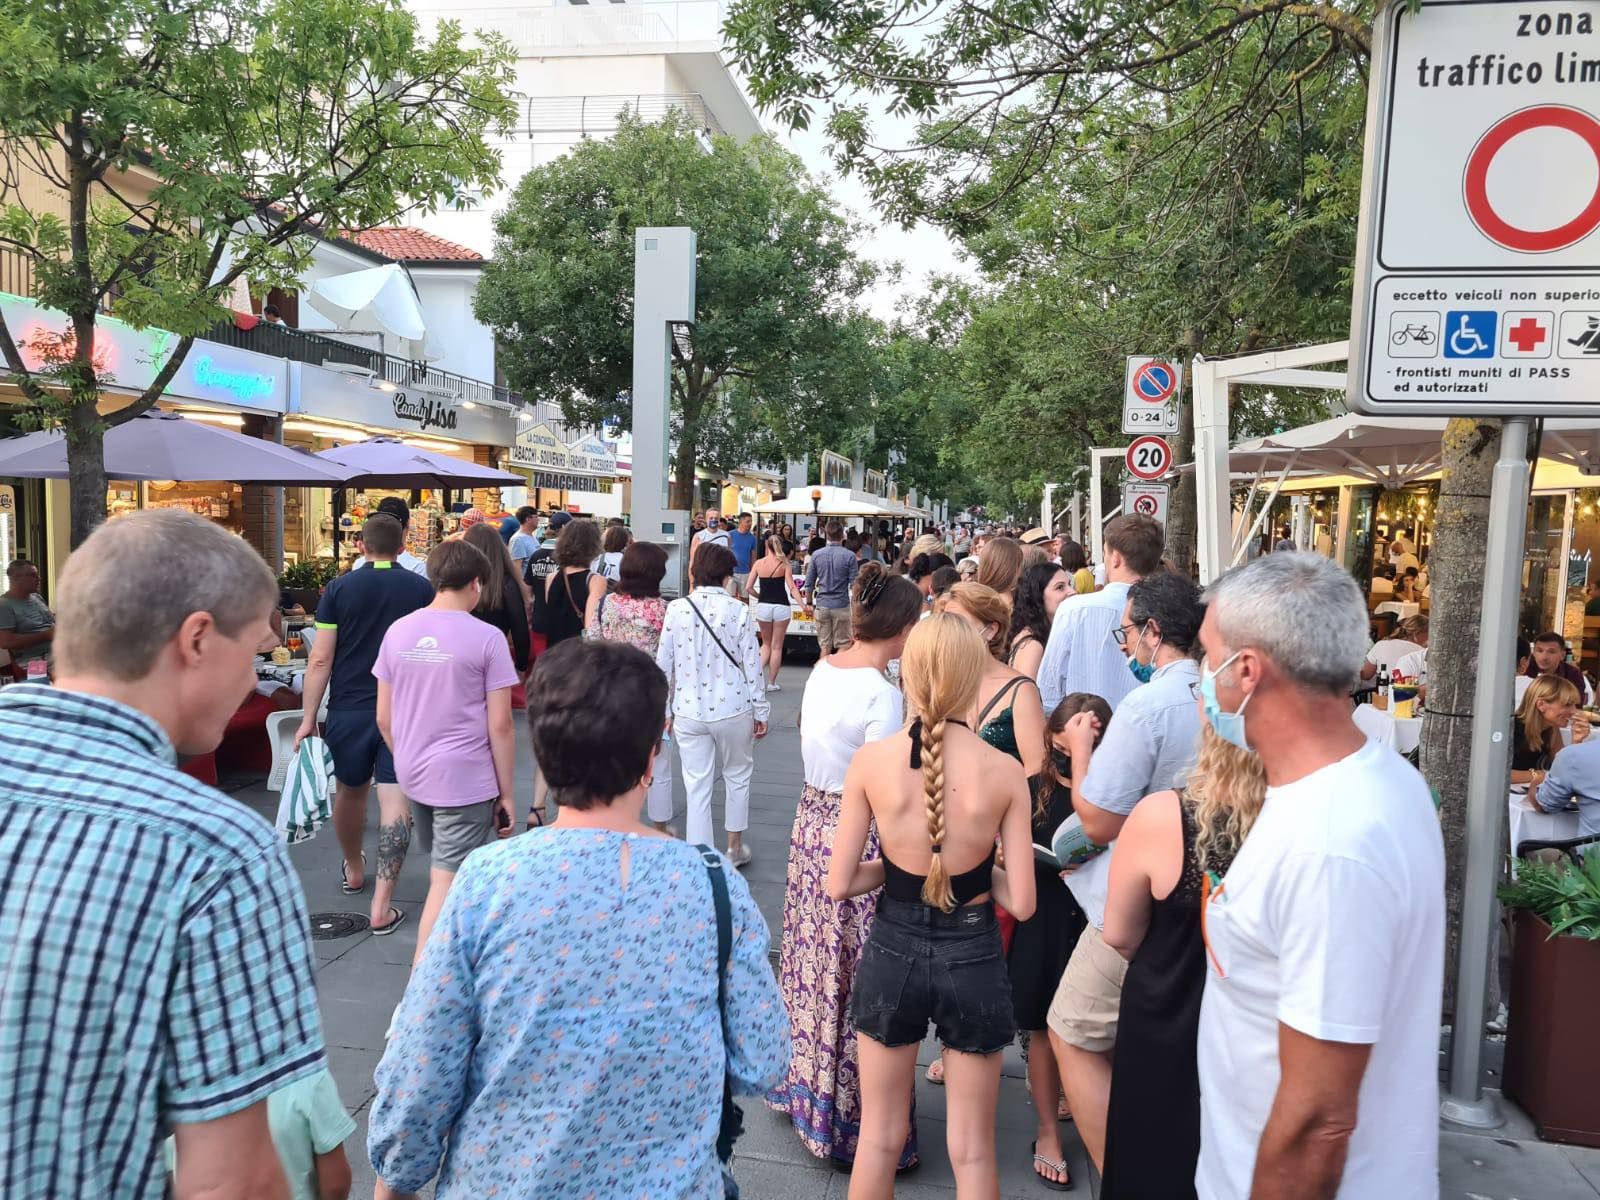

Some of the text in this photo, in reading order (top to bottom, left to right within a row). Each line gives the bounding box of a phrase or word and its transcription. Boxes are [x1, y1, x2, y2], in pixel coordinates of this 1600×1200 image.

[1516, 12, 1593, 37] zona
[1417, 53, 1543, 87] traffico
[1393, 288, 1600, 302] eccetto veicoli non superio
[1396, 367, 1452, 378] frontisti
[1459, 367, 1502, 378] muniti
[1509, 367, 1521, 378] di
[1529, 368, 1571, 378] PASS
[1394, 383, 1489, 393] ed autorizzati
[1138, 448, 1162, 468] 20
[533, 471, 598, 493] TABACCHERIA
